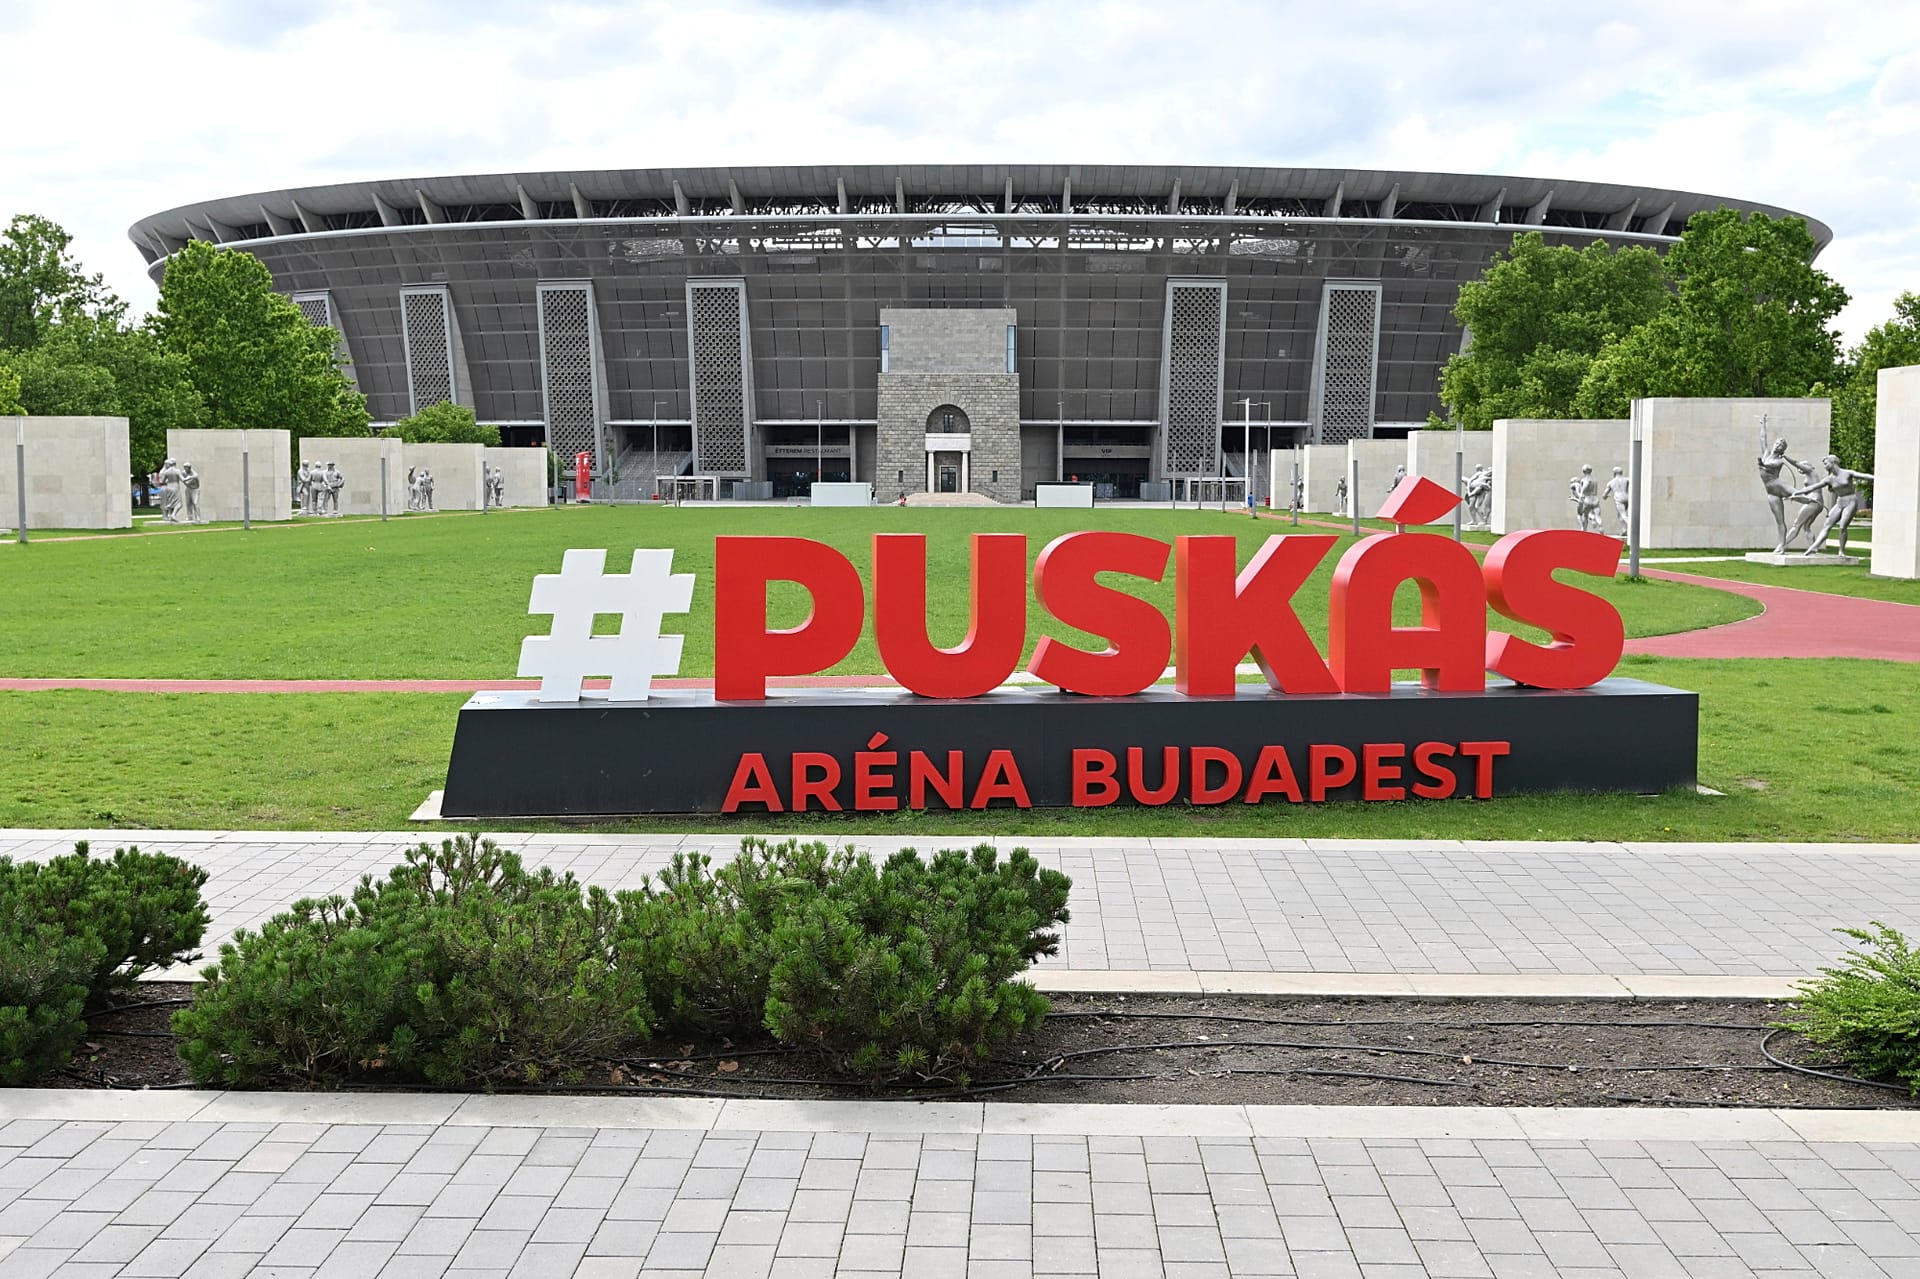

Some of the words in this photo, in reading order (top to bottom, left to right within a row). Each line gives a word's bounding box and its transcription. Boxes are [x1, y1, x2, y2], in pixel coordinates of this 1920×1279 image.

[516, 475, 1624, 702] #PUSKÁS
[721, 731, 1032, 813] ARÉNA
[1072, 741, 1510, 807] BUDAPEST
